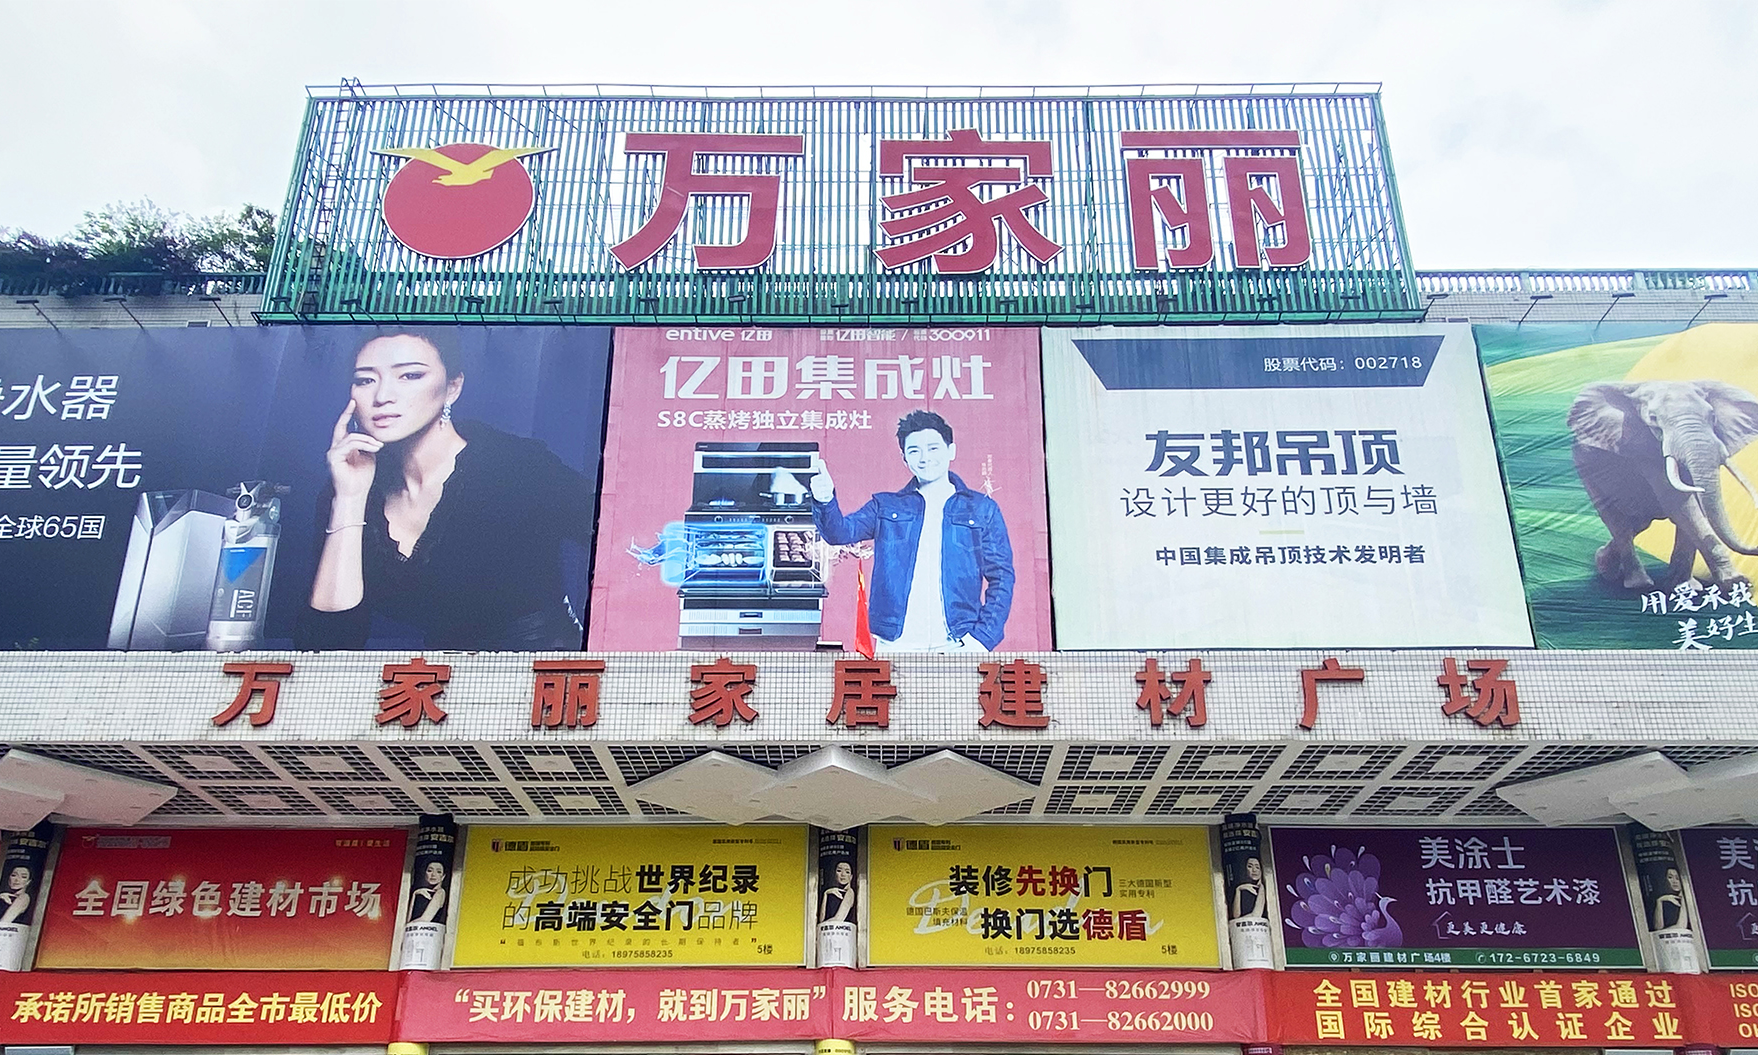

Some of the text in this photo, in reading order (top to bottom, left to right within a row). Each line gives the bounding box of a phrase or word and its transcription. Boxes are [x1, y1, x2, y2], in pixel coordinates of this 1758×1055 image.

[608, 128, 1313, 276] 万家丽
[666, 328, 773, 341] entive 亿田
[929, 329, 990, 341] 300911
[660, 355, 994, 400] 亿田集成灶
[0, 374, 119, 420] 水器
[657, 410, 872, 430] S8C蒸烤独立集成灶
[0, 443, 142, 490] 量领先
[1145, 430, 1404, 477] 友邦吊顶
[1120, 484, 1438, 517] 设计更好的顶与墙
[0, 514, 106, 540] 全球65国
[1155, 545, 1426, 567] 中国集成吊顶技术发明者
[212, 657, 1520, 728] 万家丽家居建材广场
[1421, 836, 1525, 870] 美涂士
[1716, 837, 1758, 870] 美
[505, 865, 759, 894] 成功挑战世界纪录
[949, 865, 1111, 897] 装修先换门
[1426, 878, 1601, 906] 抗甲醛艺术漆
[72, 880, 382, 918] 全国绿色建材市场
[502, 900, 759, 931] 的高端安全门品牌
[981, 908, 1147, 941] 换门选德盾
[1446, 921, 1527, 936] 更美更健康
[1489, 952, 1600, 963] 172-6723-6849
[11, 991, 383, 1024] 承诺所销售商品全市最低价
[1313, 980, 1676, 1009] 全国建材行业首家通过
[1315, 1011, 1683, 1040] 国际综合认证企业
